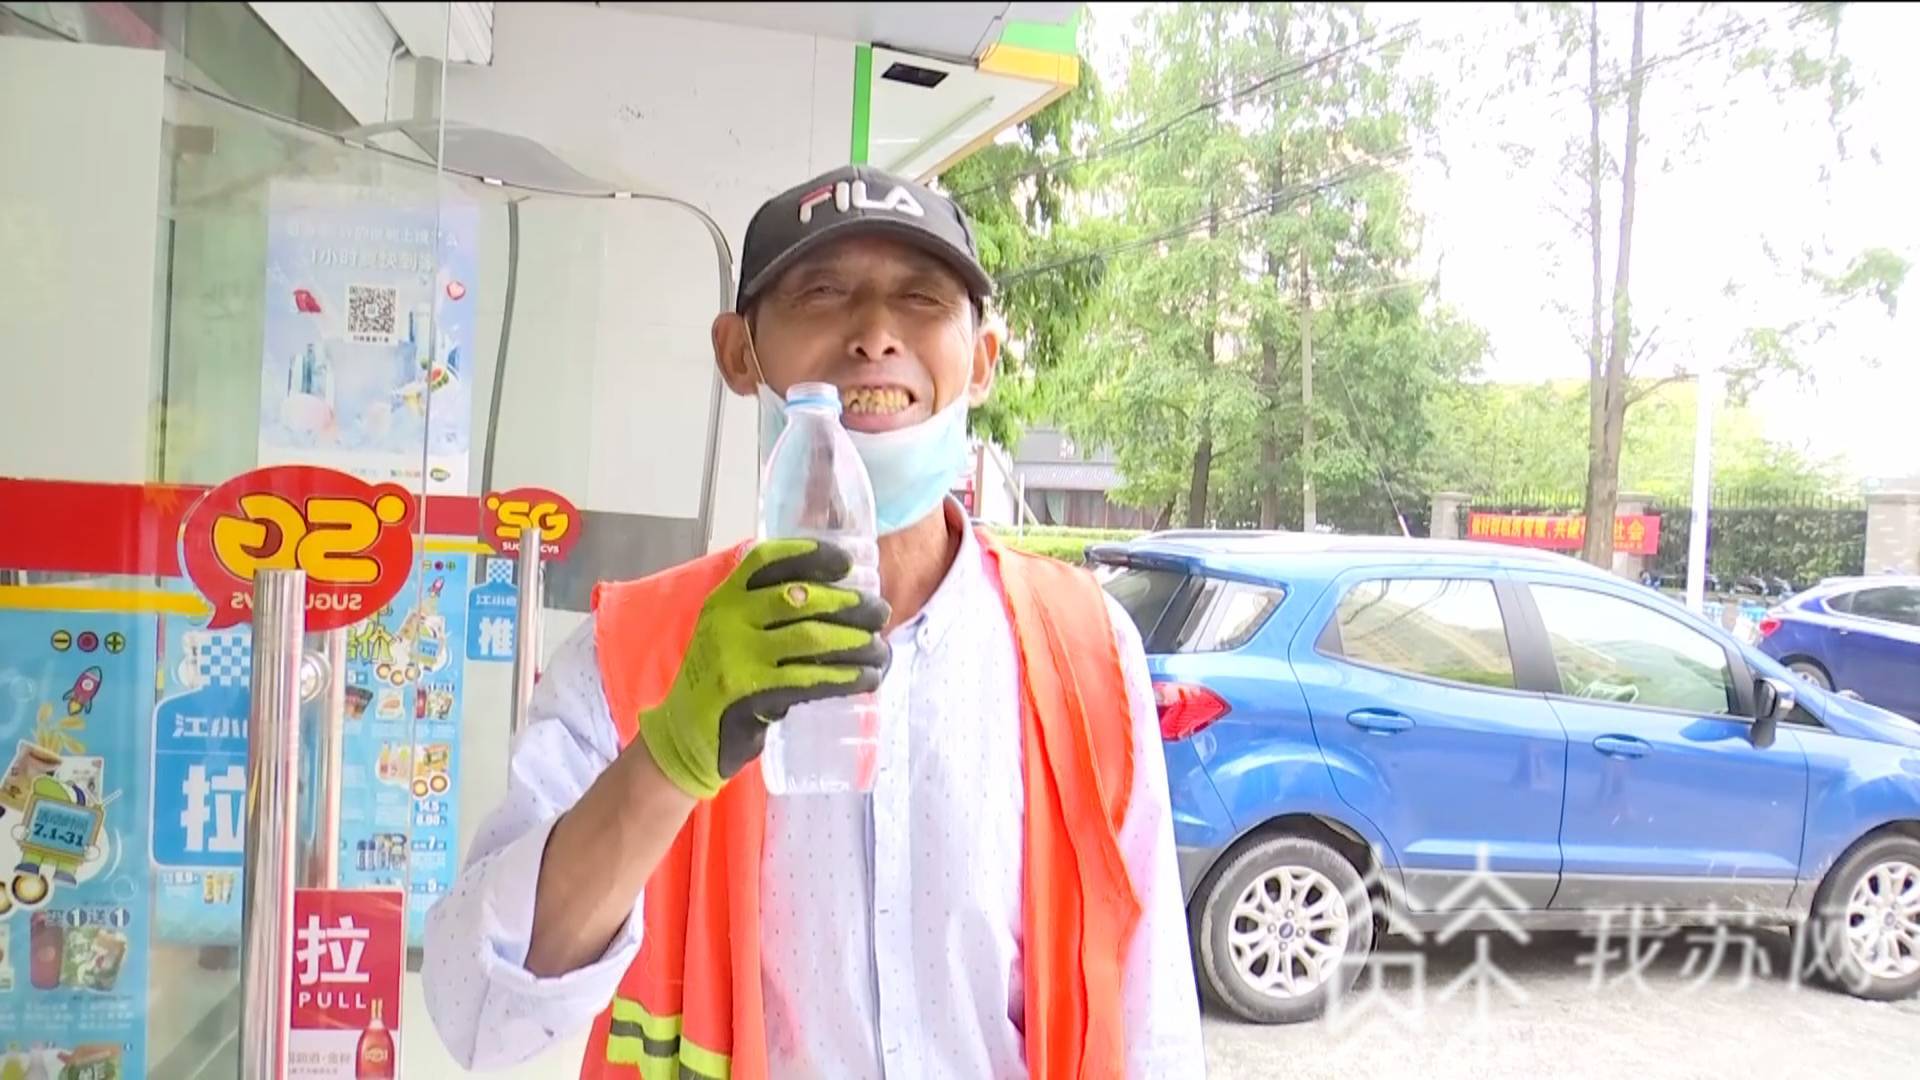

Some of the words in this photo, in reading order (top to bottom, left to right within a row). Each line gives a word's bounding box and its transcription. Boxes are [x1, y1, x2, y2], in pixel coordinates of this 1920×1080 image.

[799, 179, 925, 224] FILA
[172, 713, 248, 738] 江小
[296, 914, 370, 986] 拉
[298, 991, 367, 1009] PULL
